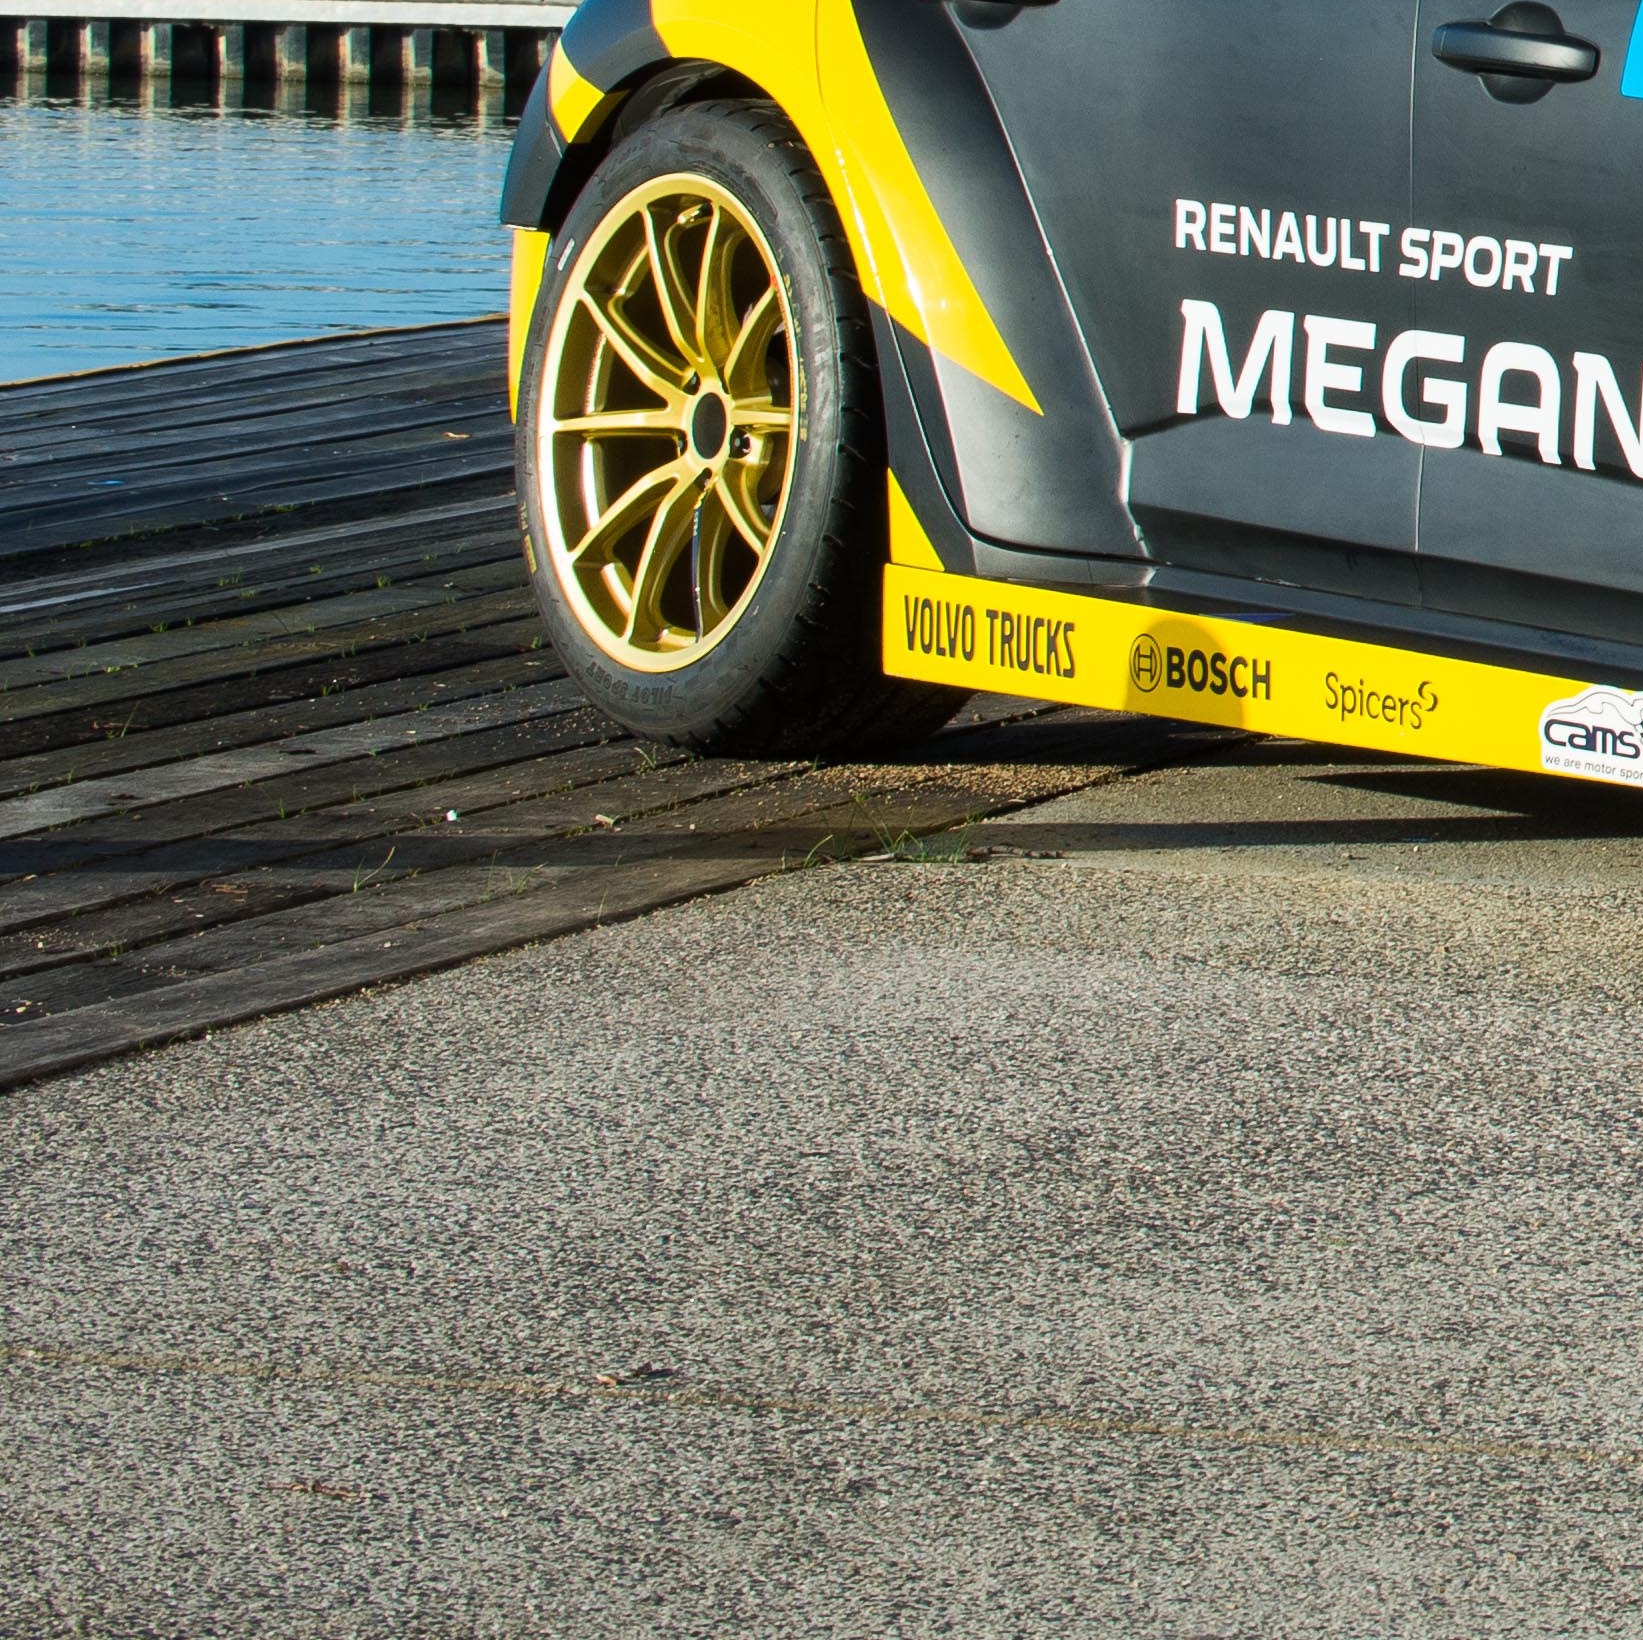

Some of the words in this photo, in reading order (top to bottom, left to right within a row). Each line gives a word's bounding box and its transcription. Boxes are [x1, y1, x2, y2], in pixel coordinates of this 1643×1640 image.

[1174, 198, 1391, 274] RENAULT
[1398, 227, 1575, 297] SPORT
[903, 594, 976, 663] VOLVO
[985, 609, 1076, 680] TRUCKS
[1165, 645, 1272, 701] BOSCH
[1323, 671, 1424, 731] Spicers
[1544, 718, 1641, 760] cams
[1545, 755, 1561, 765] we
[1563, 759, 1581, 769] are
[1584, 761, 1617, 775] motor
